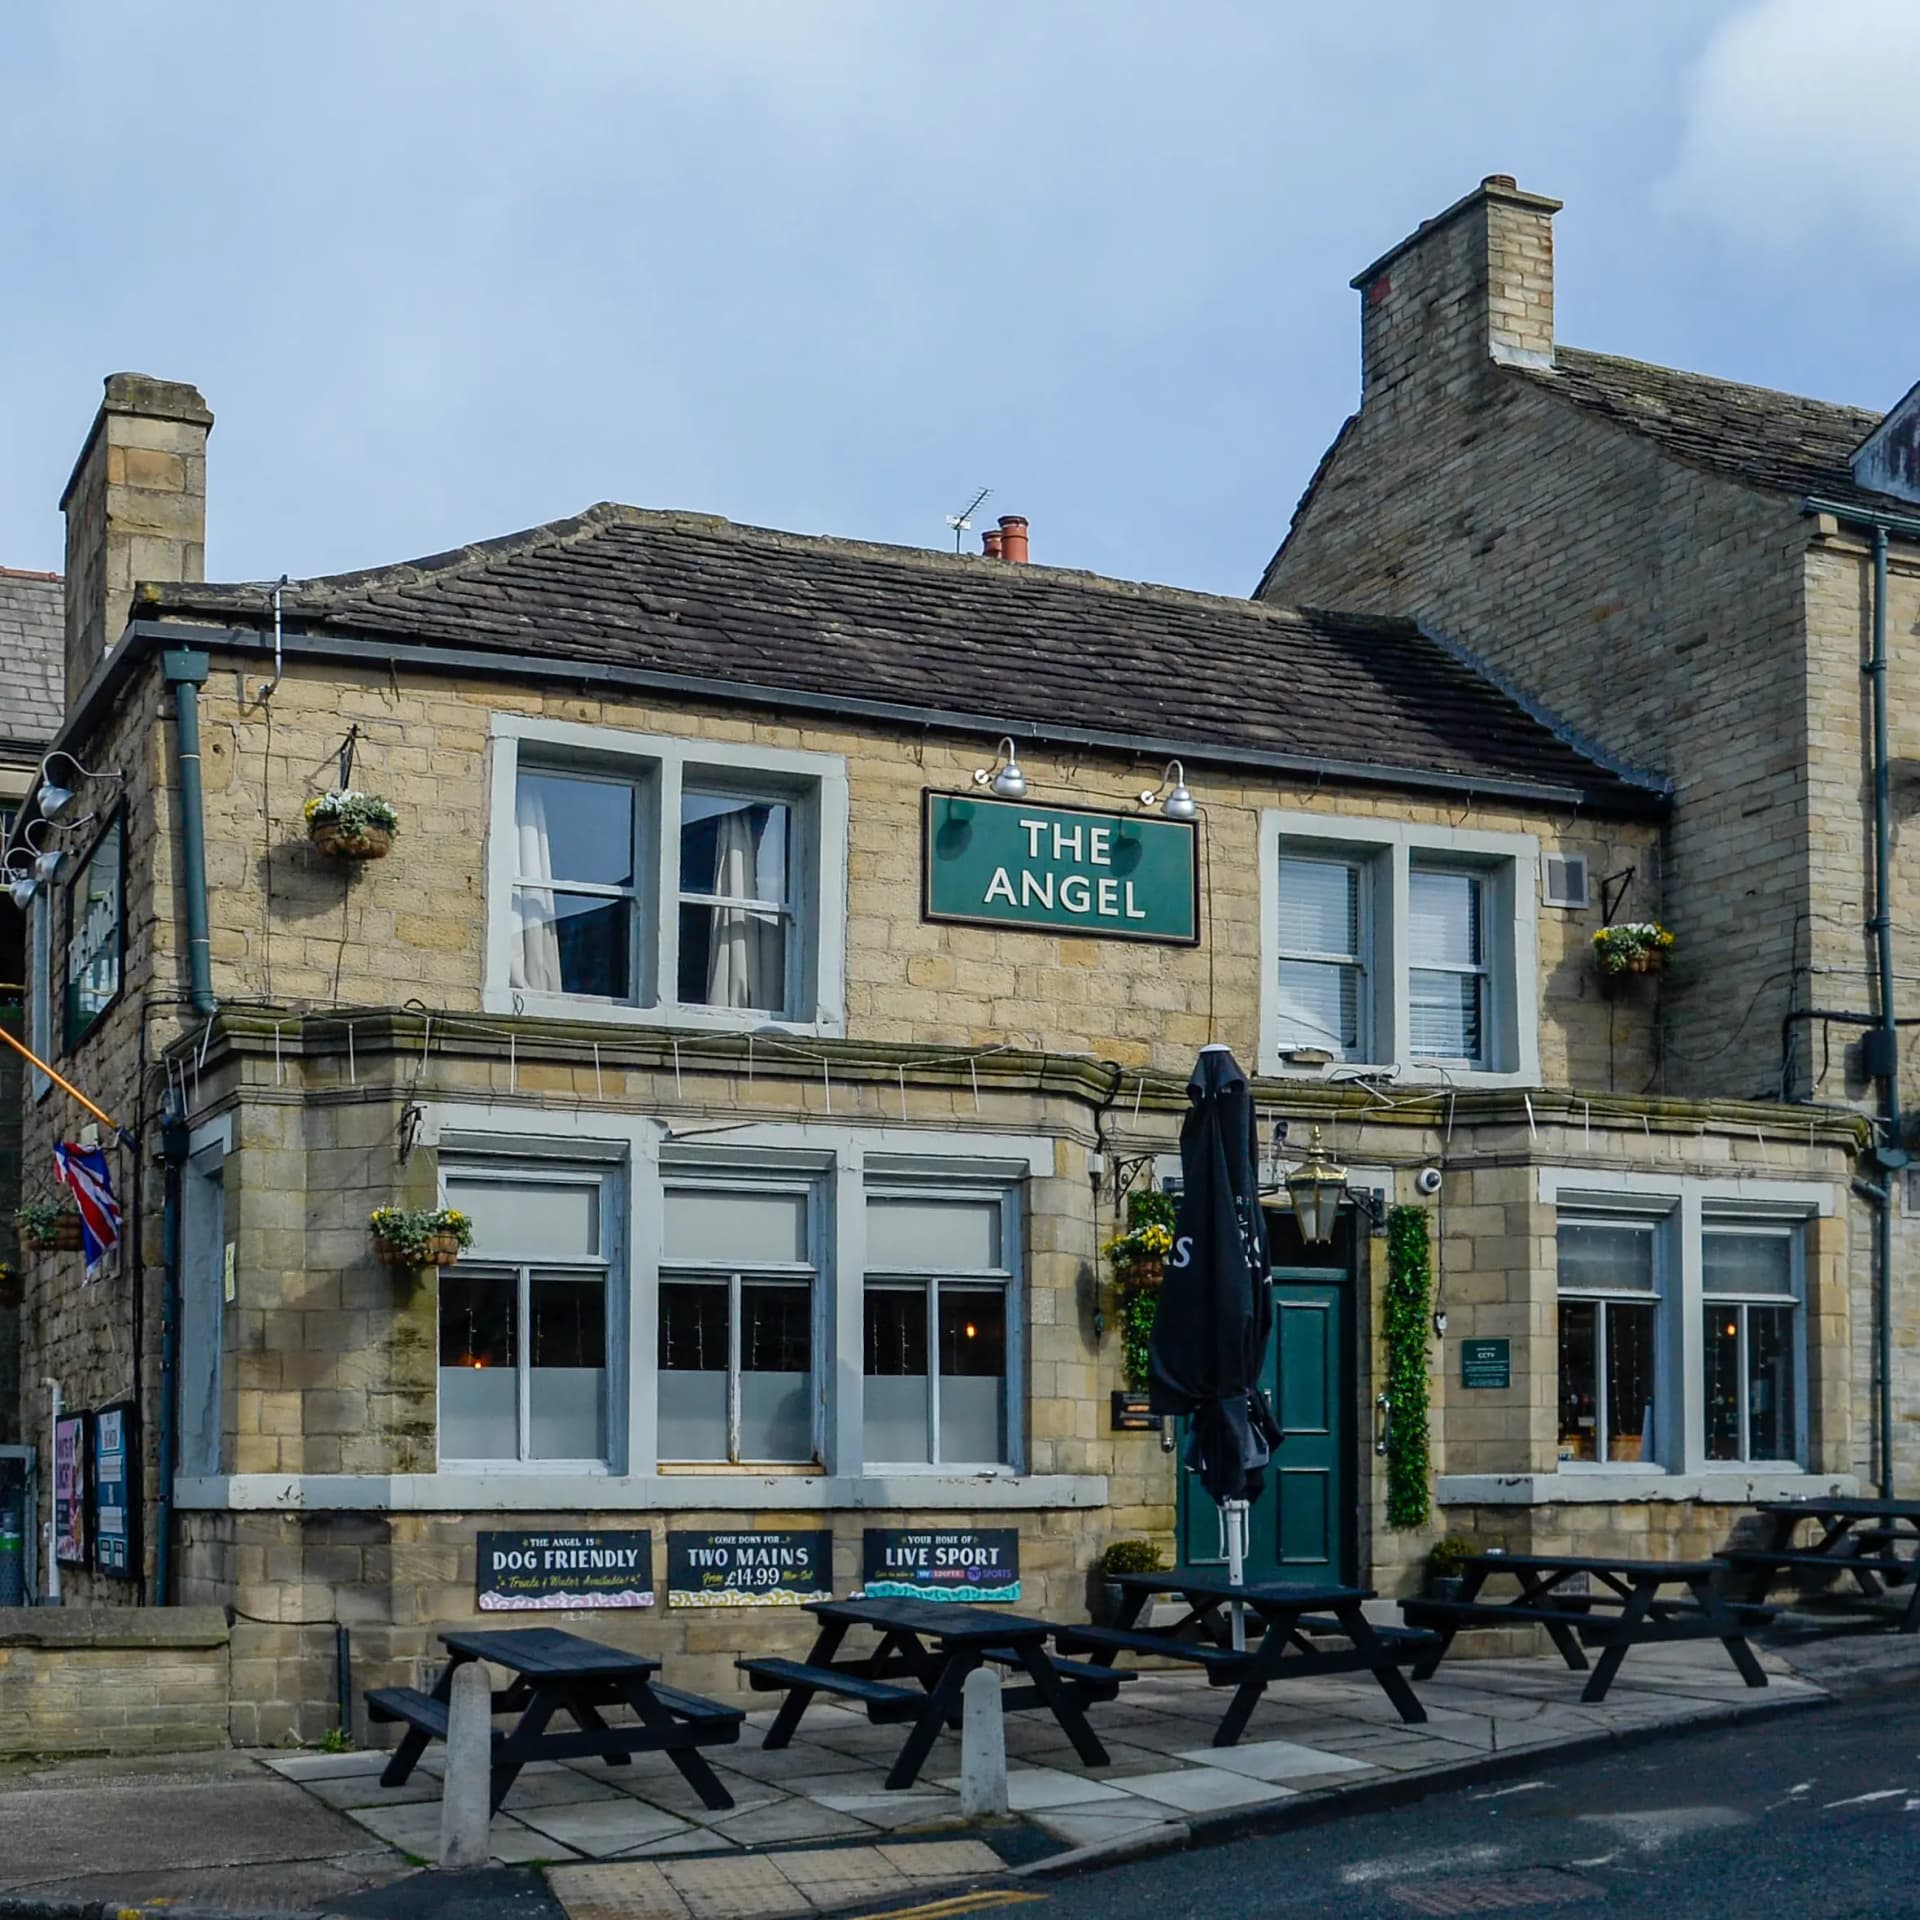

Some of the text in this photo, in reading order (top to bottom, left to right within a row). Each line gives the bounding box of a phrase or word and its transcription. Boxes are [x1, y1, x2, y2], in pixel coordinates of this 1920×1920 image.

[1019, 819, 1111, 865] THE
[984, 867, 1146, 918] ANGEL
[530, 1538, 595, 1547] THE ANGEL IS
[715, 1536, 736, 1544] COME
[738, 1536, 761, 1544] DOWN
[908, 1536, 931, 1544] YOUR
[961, 1536, 972, 1544] OF
[493, 1550, 638, 1570] DOG FRIENDLY
[688, 1548, 809, 1567] TWO MAINS
[885, 1548, 1000, 1566] LIVE SPORT
[725, 1568, 780, 1586] £14.99
[983, 1569, 1011, 1578] SPORTS
